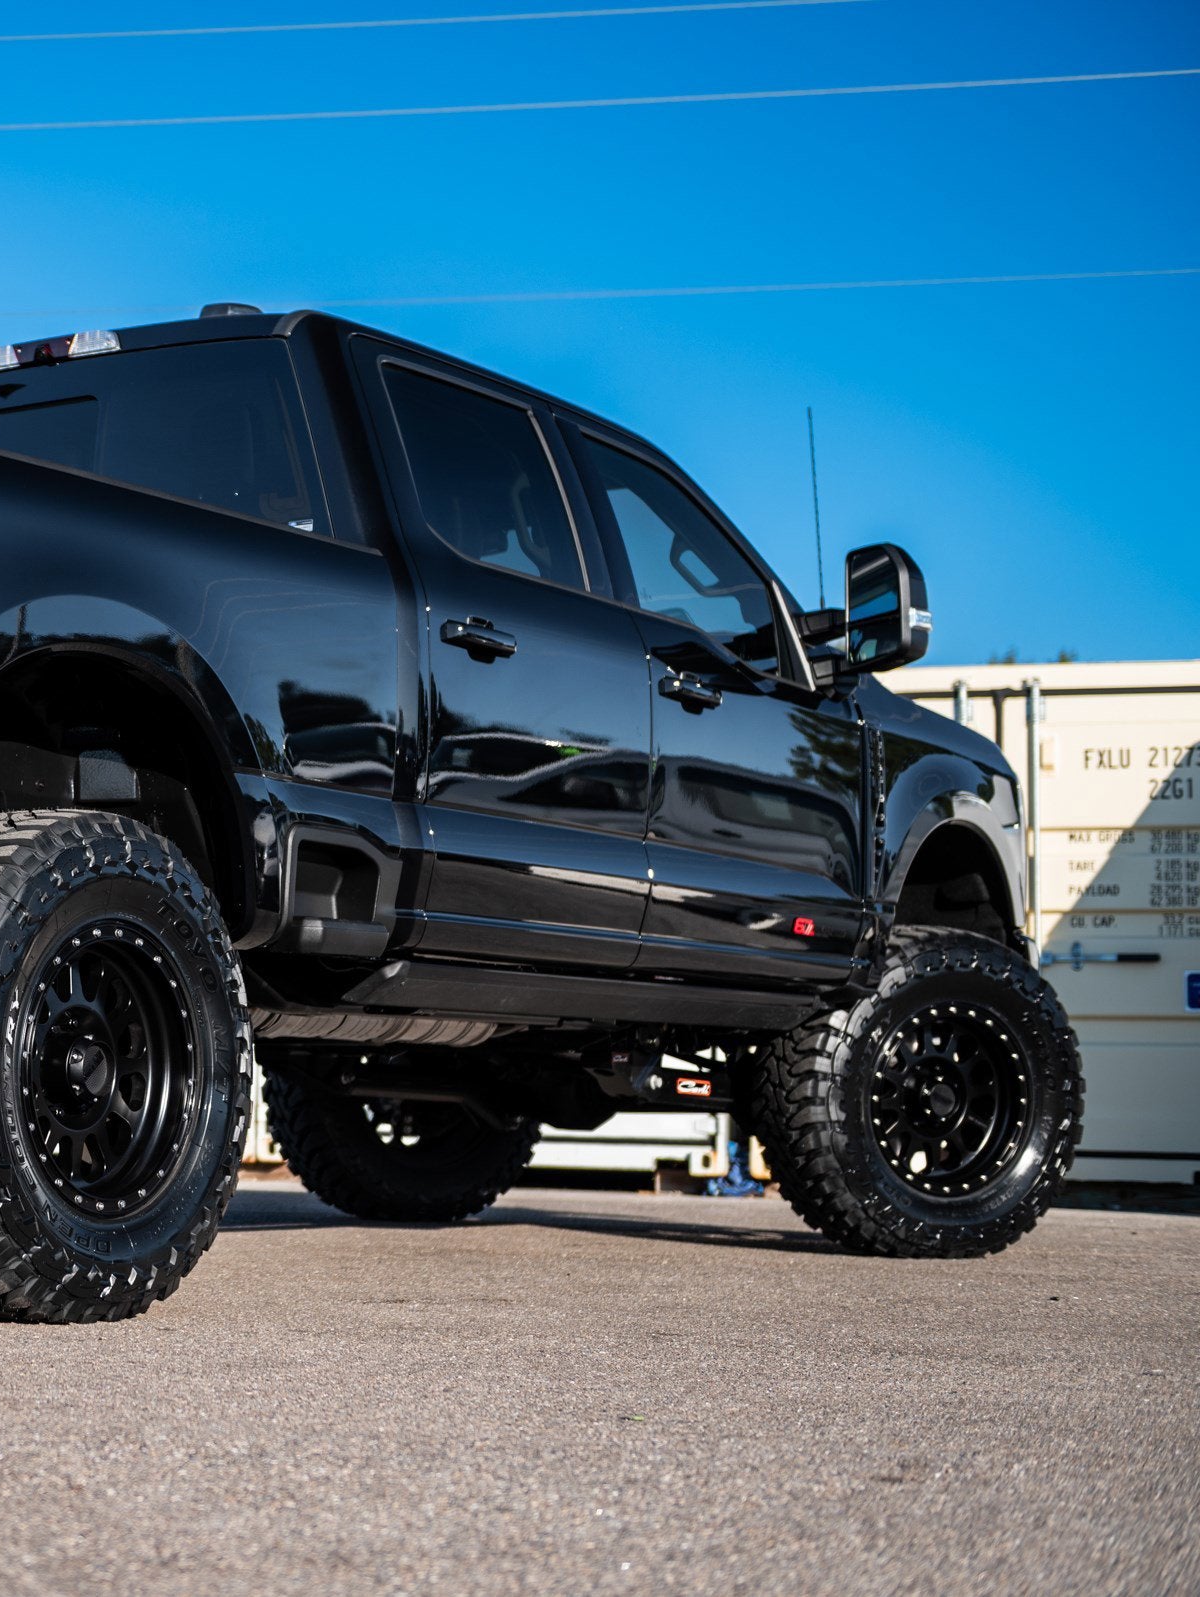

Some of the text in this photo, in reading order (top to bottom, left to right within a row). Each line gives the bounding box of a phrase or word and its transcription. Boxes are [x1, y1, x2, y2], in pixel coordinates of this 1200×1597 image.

[1084, 748, 1131, 769] FXLU
[1149, 778, 1194, 800] 22G1
[1068, 884, 1120, 896] PAYLOAD
[156, 896, 220, 993] TOYO
[41, 1199, 112, 1255] OPEN
